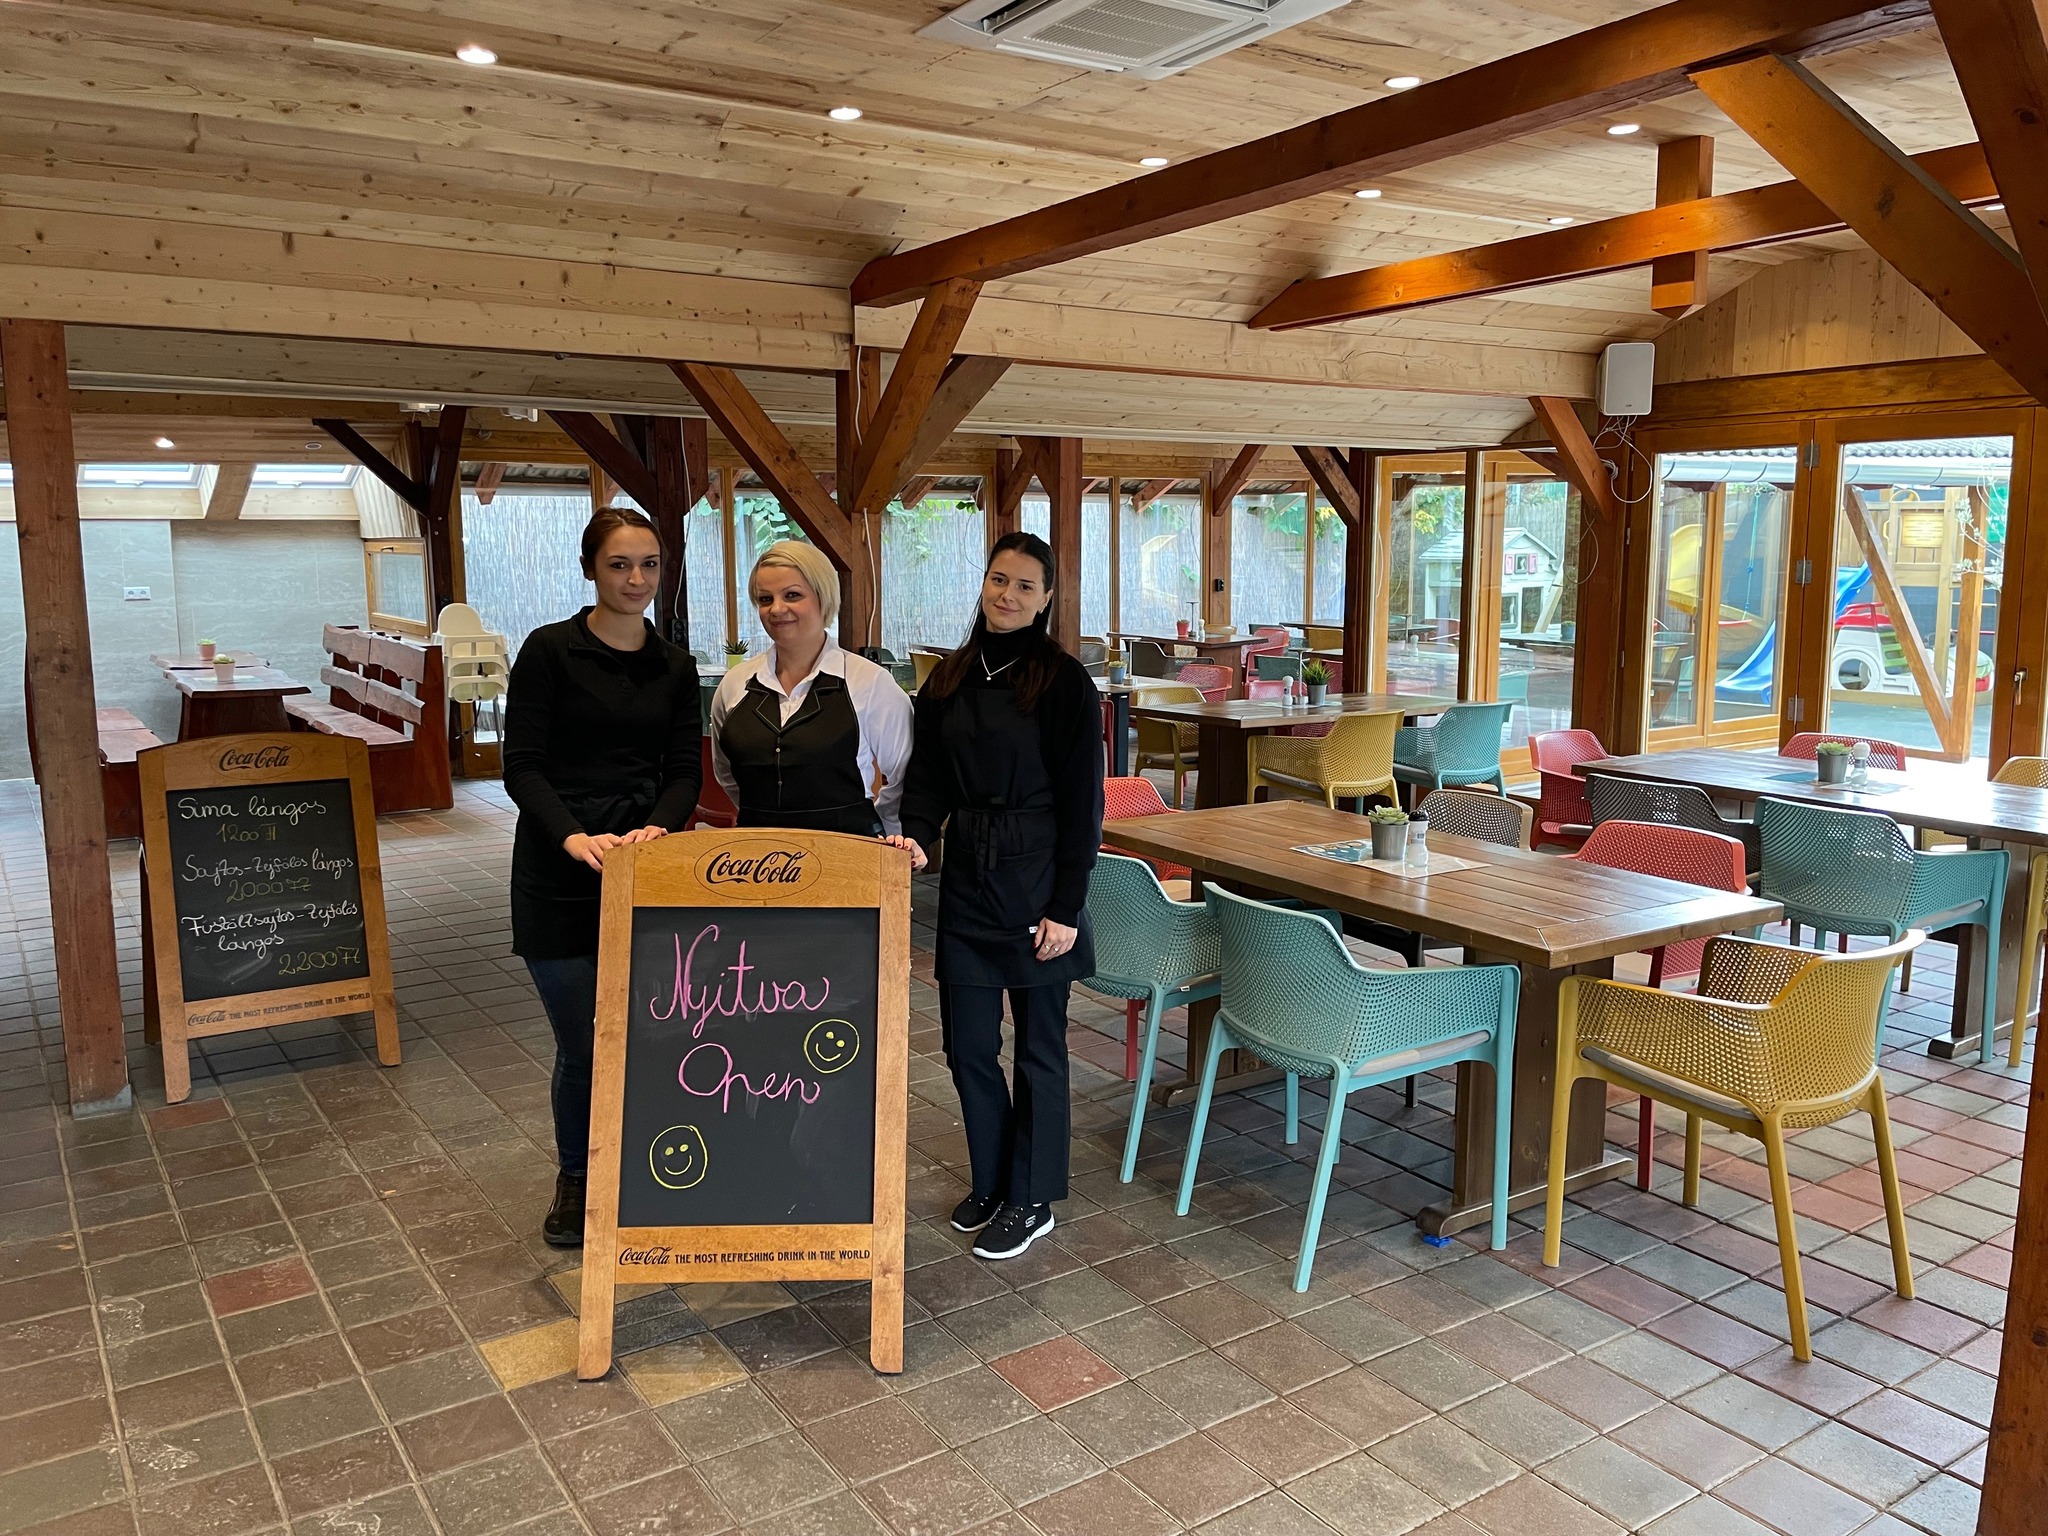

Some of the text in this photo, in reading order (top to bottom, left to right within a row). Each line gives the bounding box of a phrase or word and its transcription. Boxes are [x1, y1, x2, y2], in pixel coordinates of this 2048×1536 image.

[178, 797, 239, 819] Sima
[216, 823, 259, 842] 1200
[226, 879, 284, 903] 2000
[650, 924, 830, 1038] Nyitva
[244, 1009, 261, 1017] MOST
[263, 1003, 302, 1014] REFRESHING
[304, 1000, 324, 1008] DRINK
[348, 993, 371, 1001] WORLD
[678, 1043, 820, 1113] Open
[675, 1254, 691, 1264] THE
[694, 1253, 718, 1263] MOST
[720, 1252, 775, 1263] REFRESHING
[777, 1251, 805, 1261] DRINK
[807, 1250, 817, 1260] IN
[820, 1250, 836, 1260] THE
[839, 1249, 871, 1259] WORLD
